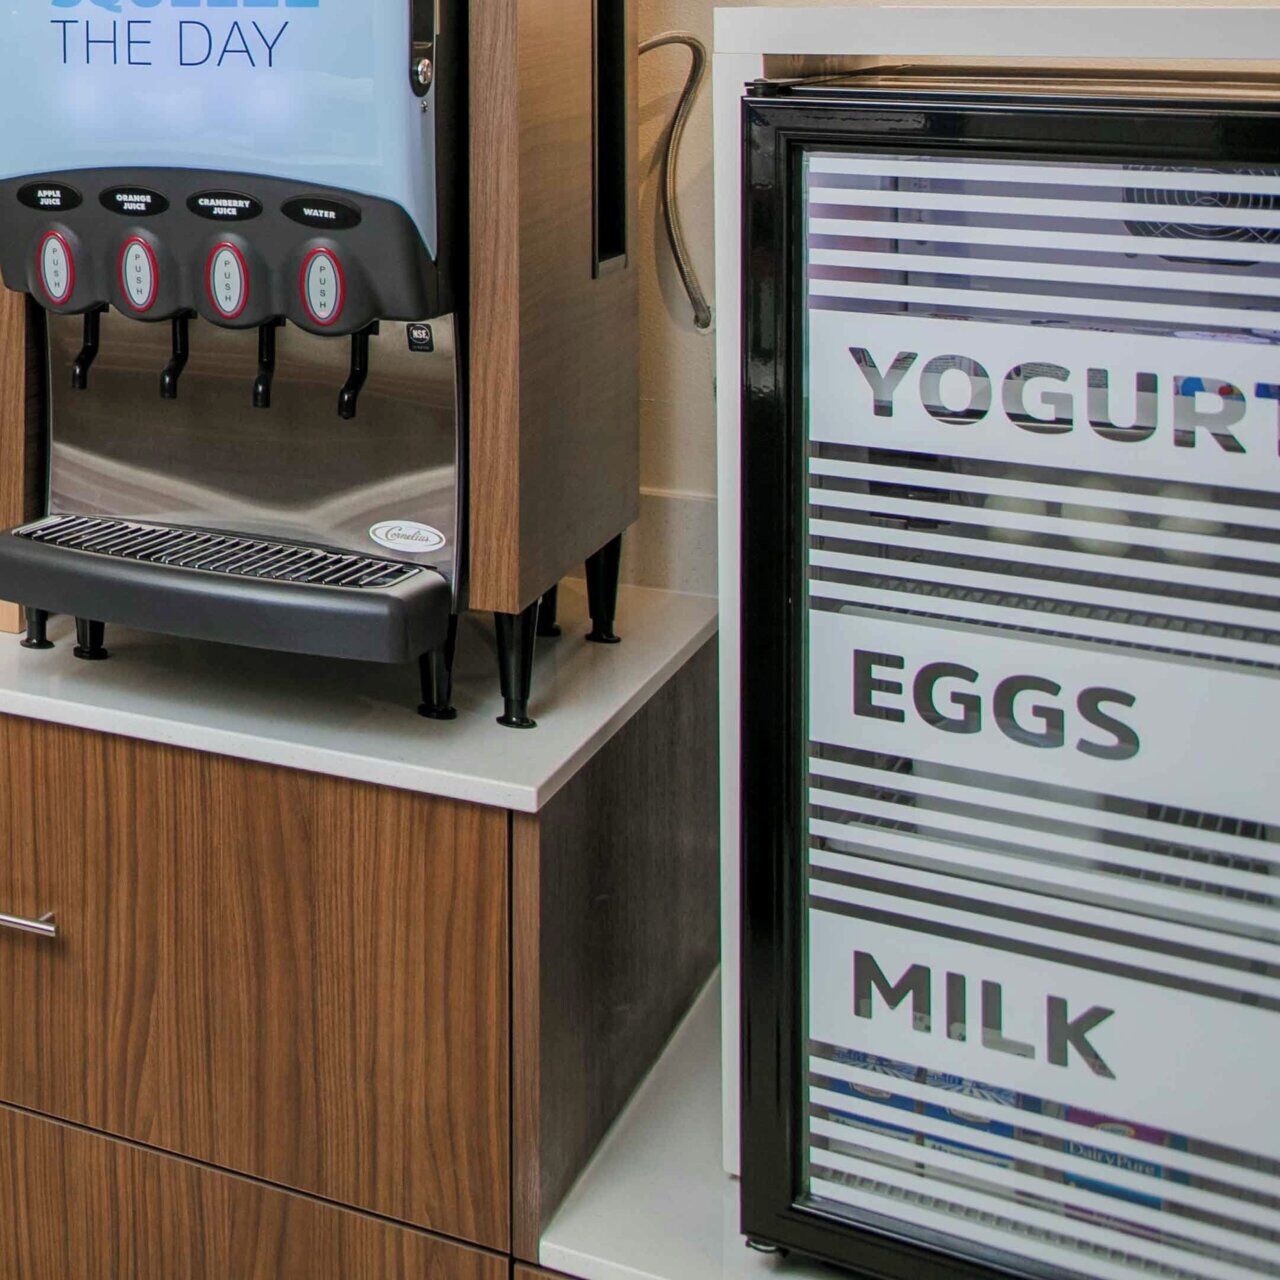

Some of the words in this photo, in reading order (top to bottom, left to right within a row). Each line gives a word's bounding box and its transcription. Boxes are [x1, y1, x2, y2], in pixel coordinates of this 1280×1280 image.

[50, 19, 152, 66] THE
[179, 19, 290, 68] DAY
[37, 190, 61, 198] APPLE
[116, 194, 152, 203] ORANGE
[123, 202, 146, 210] JUICE
[198, 197, 251, 209] CRANBERRY
[212, 207, 237, 216] JUICE
[303, 207, 336, 219] WATER
[52, 247, 61, 289] PUSH
[134, 253, 143, 295] PUSH
[224, 260, 232, 302] PUSH
[319, 265, 327, 308] PUSH
[853, 649, 1140, 761] EGGS
[853, 950, 1117, 1080] MILK
